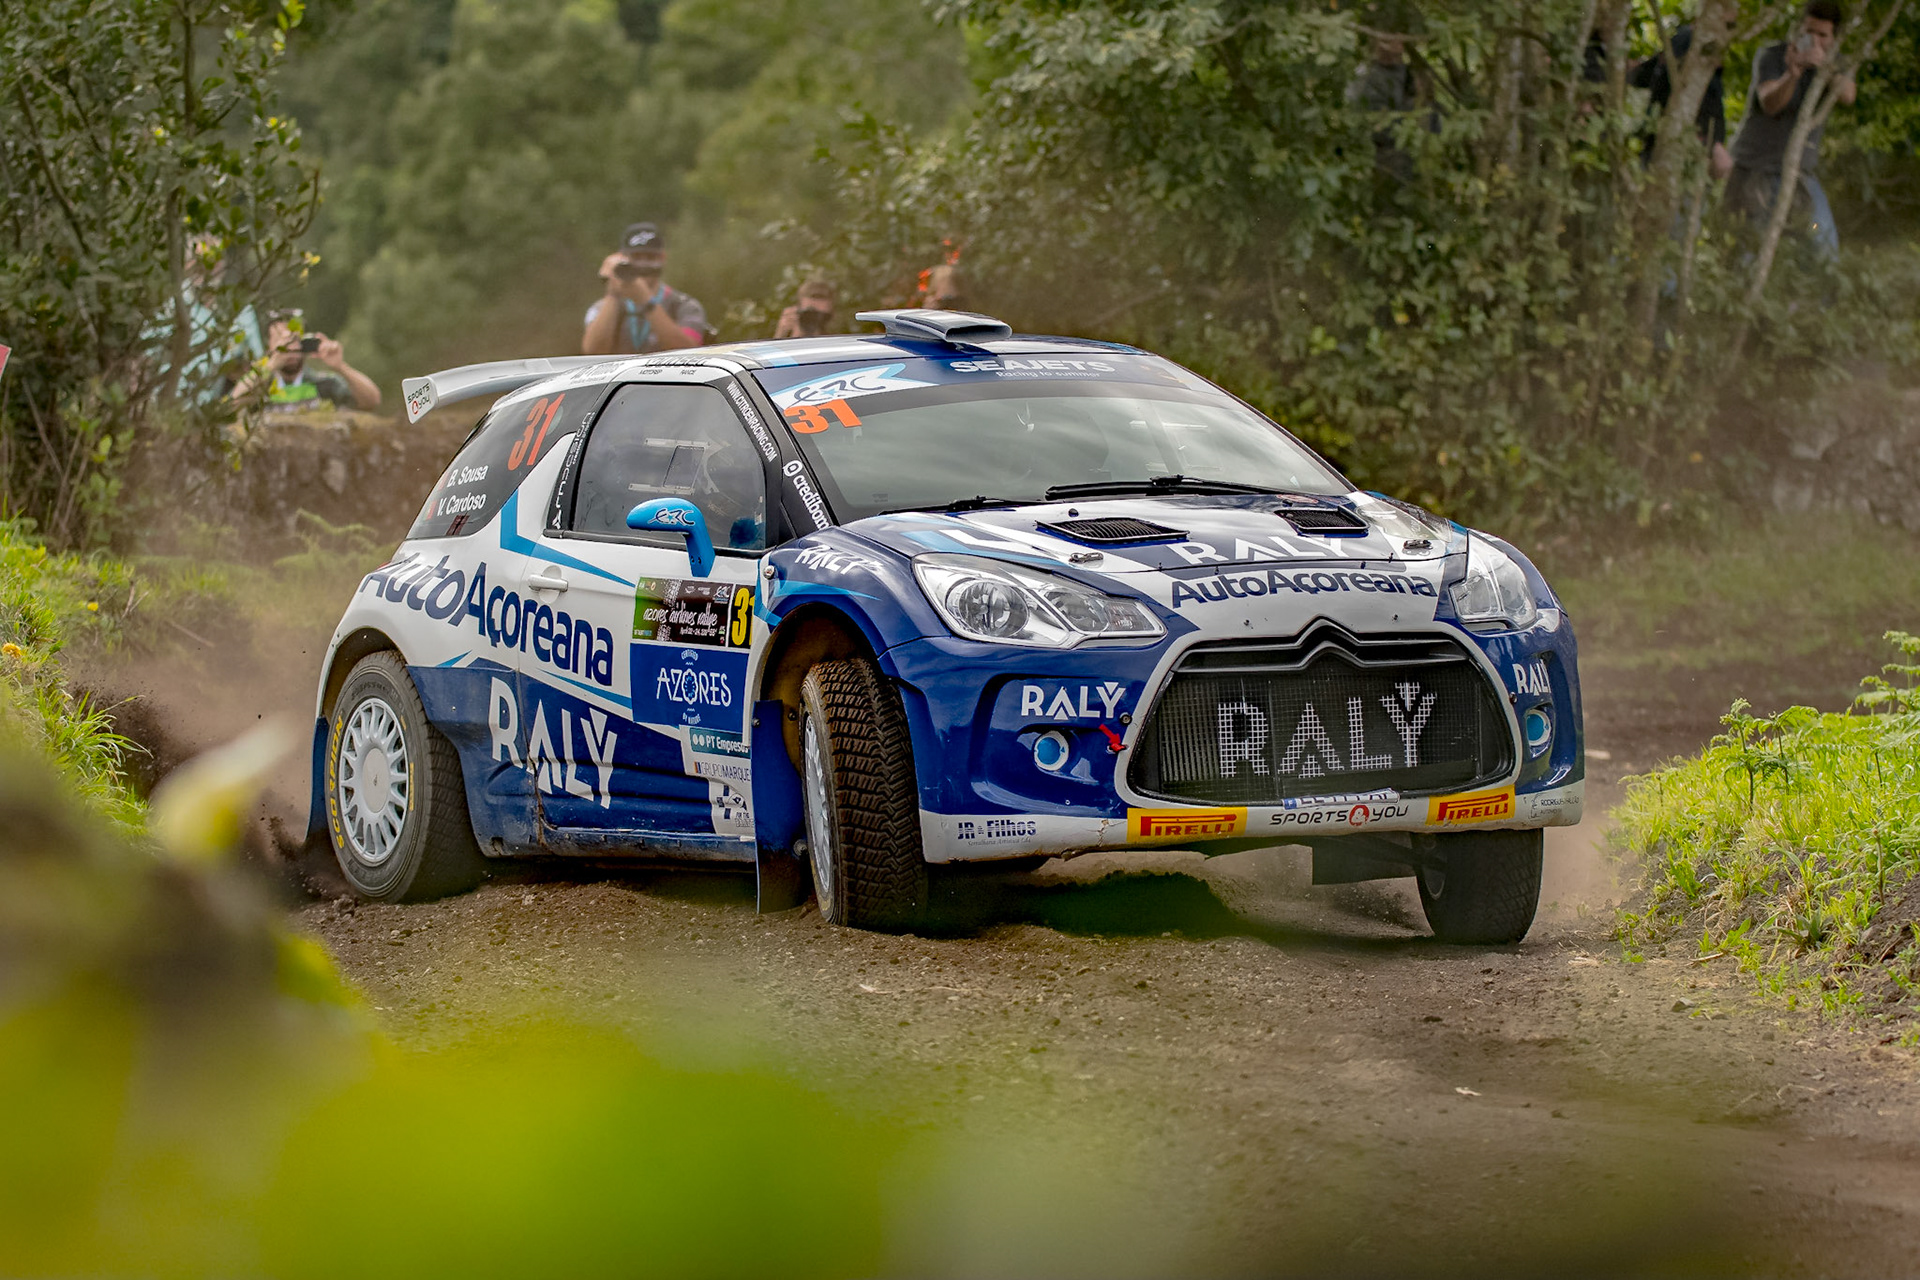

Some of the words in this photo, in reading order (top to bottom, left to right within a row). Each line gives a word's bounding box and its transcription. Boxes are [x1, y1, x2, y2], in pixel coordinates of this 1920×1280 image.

[949, 359, 1116, 372] SEAJETS
[996, 370, 1038, 379] Racing
[1039, 370, 1053, 378] to
[407, 382, 431, 403] SPORTS
[726, 380, 777, 462] WWW.CITROENRACING.COM
[783, 399, 862, 434] 31
[507, 393, 566, 471] 31
[447, 466, 457, 488] B.
[458, 464, 489, 486] Sousa
[437, 497, 445, 517] V.
[446, 491, 487, 515] Cardoso
[1172, 570, 1438, 609] AutoAçoreana
[359, 552, 614, 687] AutoAçoreana
[656, 668, 732, 707] AZORES
[1021, 682, 1126, 721] RALY
[489, 676, 617, 809] RALY
[706, 734, 715, 748] PT
[1217, 682, 1438, 779] RALY
[1270, 809, 1348, 825] SPORTS
[1372, 805, 1408, 822] YOU
[1437, 793, 1509, 822] PIRELLI
[958, 822, 975, 839] JR
[986, 819, 1036, 838] Filhos
[1140, 814, 1237, 837] PIRELLI
